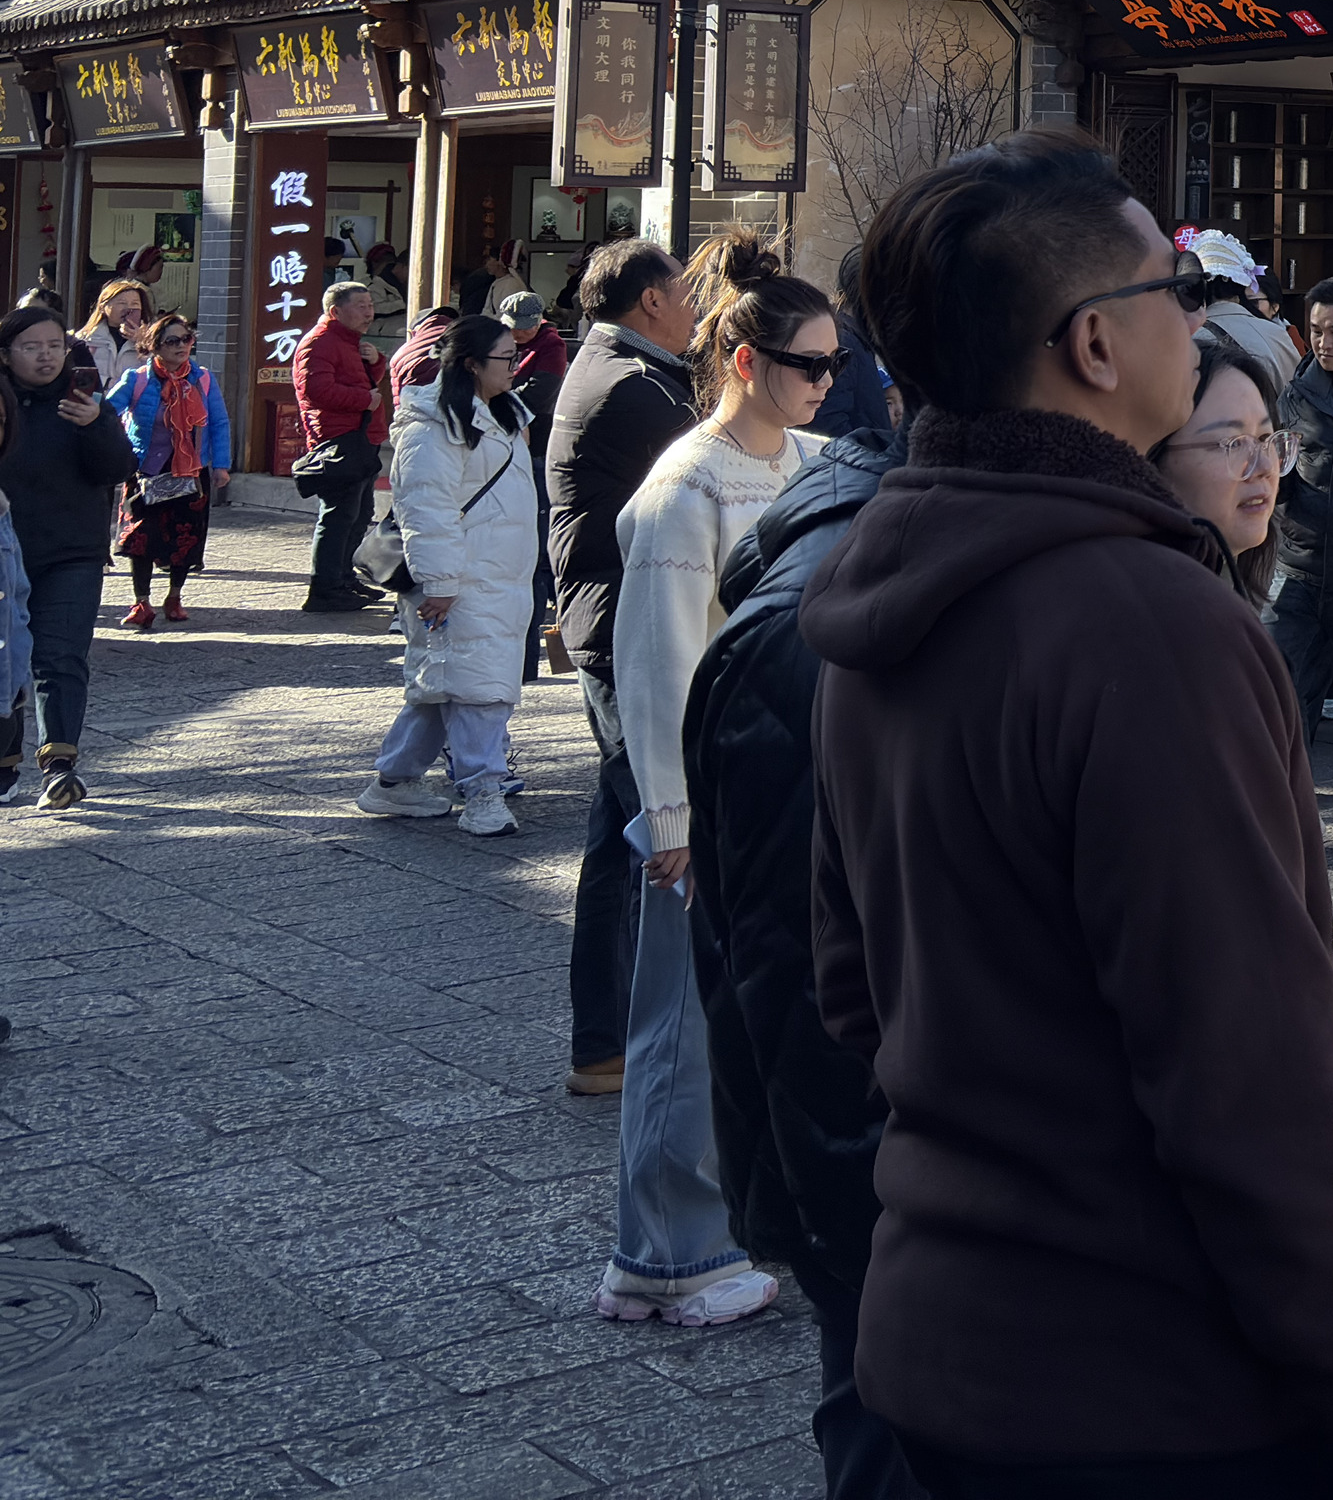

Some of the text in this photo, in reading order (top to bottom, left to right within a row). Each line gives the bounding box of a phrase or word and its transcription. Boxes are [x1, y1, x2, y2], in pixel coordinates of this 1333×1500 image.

[594, 16, 611, 84] 文明大理
[618, 37, 637, 104] 你我同行
[522, 85, 556, 98] JIAOYIZHO
[263, 170, 313, 363] 假一赔十万
[1175, 228, 1200, 250] 母
